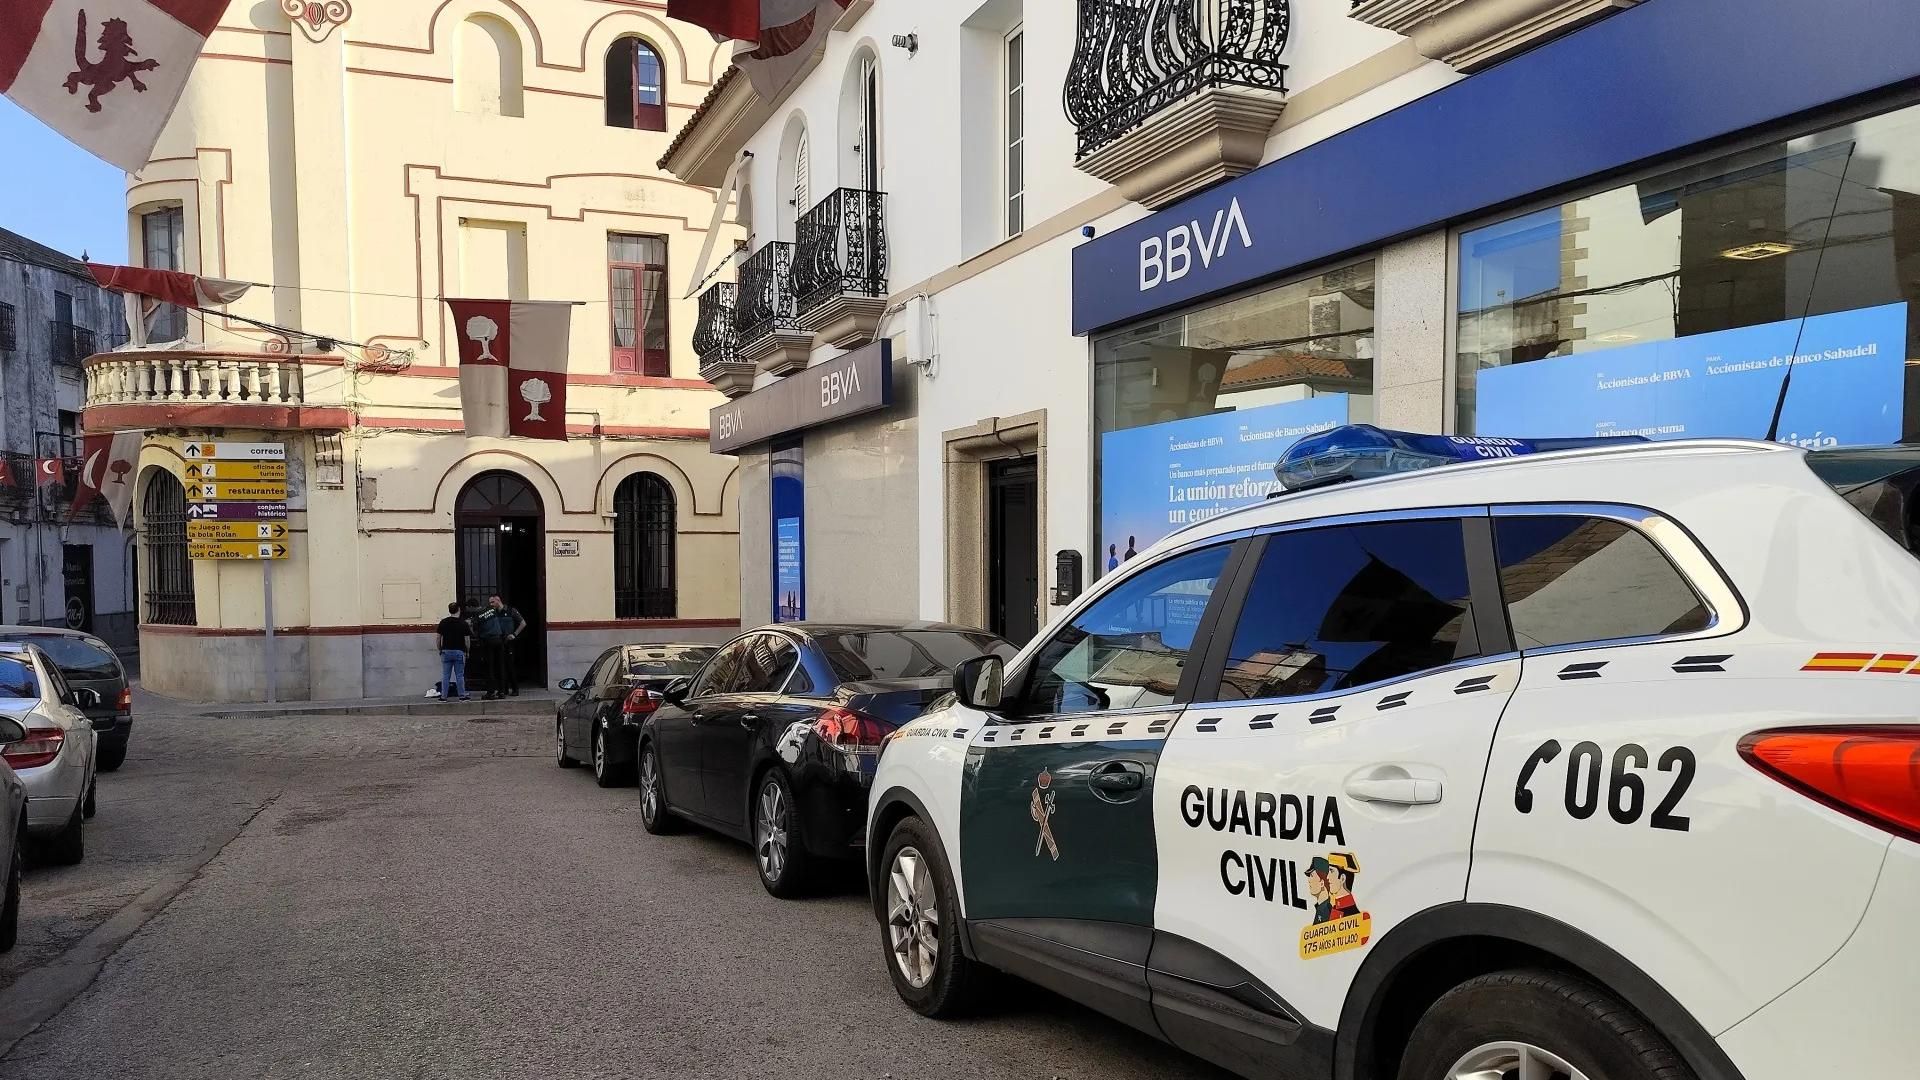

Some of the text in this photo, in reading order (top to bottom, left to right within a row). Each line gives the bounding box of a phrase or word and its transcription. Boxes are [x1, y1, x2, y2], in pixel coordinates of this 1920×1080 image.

[1140, 196, 1252, 291] BBVA
[1706, 343, 1877, 376] Accionistas de Banco Sabadell
[821, 361, 860, 407] BBVA
[1597, 368, 1691, 391] Accionistas de BBVA
[720, 407, 743, 440] BBVA
[1639, 427, 1657, 437] que
[1658, 424, 1685, 434] suma
[1200, 439, 1207, 448] de
[1208, 436, 1223, 446] BBVA
[1239, 432, 1274, 442] Accionistas
[1275, 429, 1283, 437] de
[1284, 427, 1305, 436] Banco
[1450, 436, 1525, 447] GUARDIA
[1475, 445, 1519, 457] CIVIL
[1169, 470, 1177, 478] Un
[1178, 469, 1194, 478] banco
[1194, 468, 1206, 476] más
[1206, 465, 1236, 477] preparado
[1237, 464, 1251, 475] para
[1252, 462, 1257, 471] el
[228, 487, 285, 495] restaurantes
[1169, 477, 1288, 502] La unión reforza
[1169, 509, 1186, 524] un
[208, 550, 240, 558] Cantos
[906, 728, 949, 738] GUARDIA CIVIL
[1564, 741, 1696, 832] 062
[1180, 784, 1346, 846] GUARDIA
[1220, 849, 1308, 910] CIVIL
[1303, 918, 1360, 941] GUARDIA CIVIL
[1303, 941, 1318, 954] 175
[1332, 940, 1335, 948] A
[1336, 937, 1344, 946] TU
[1344, 933, 1359, 945] LADO
